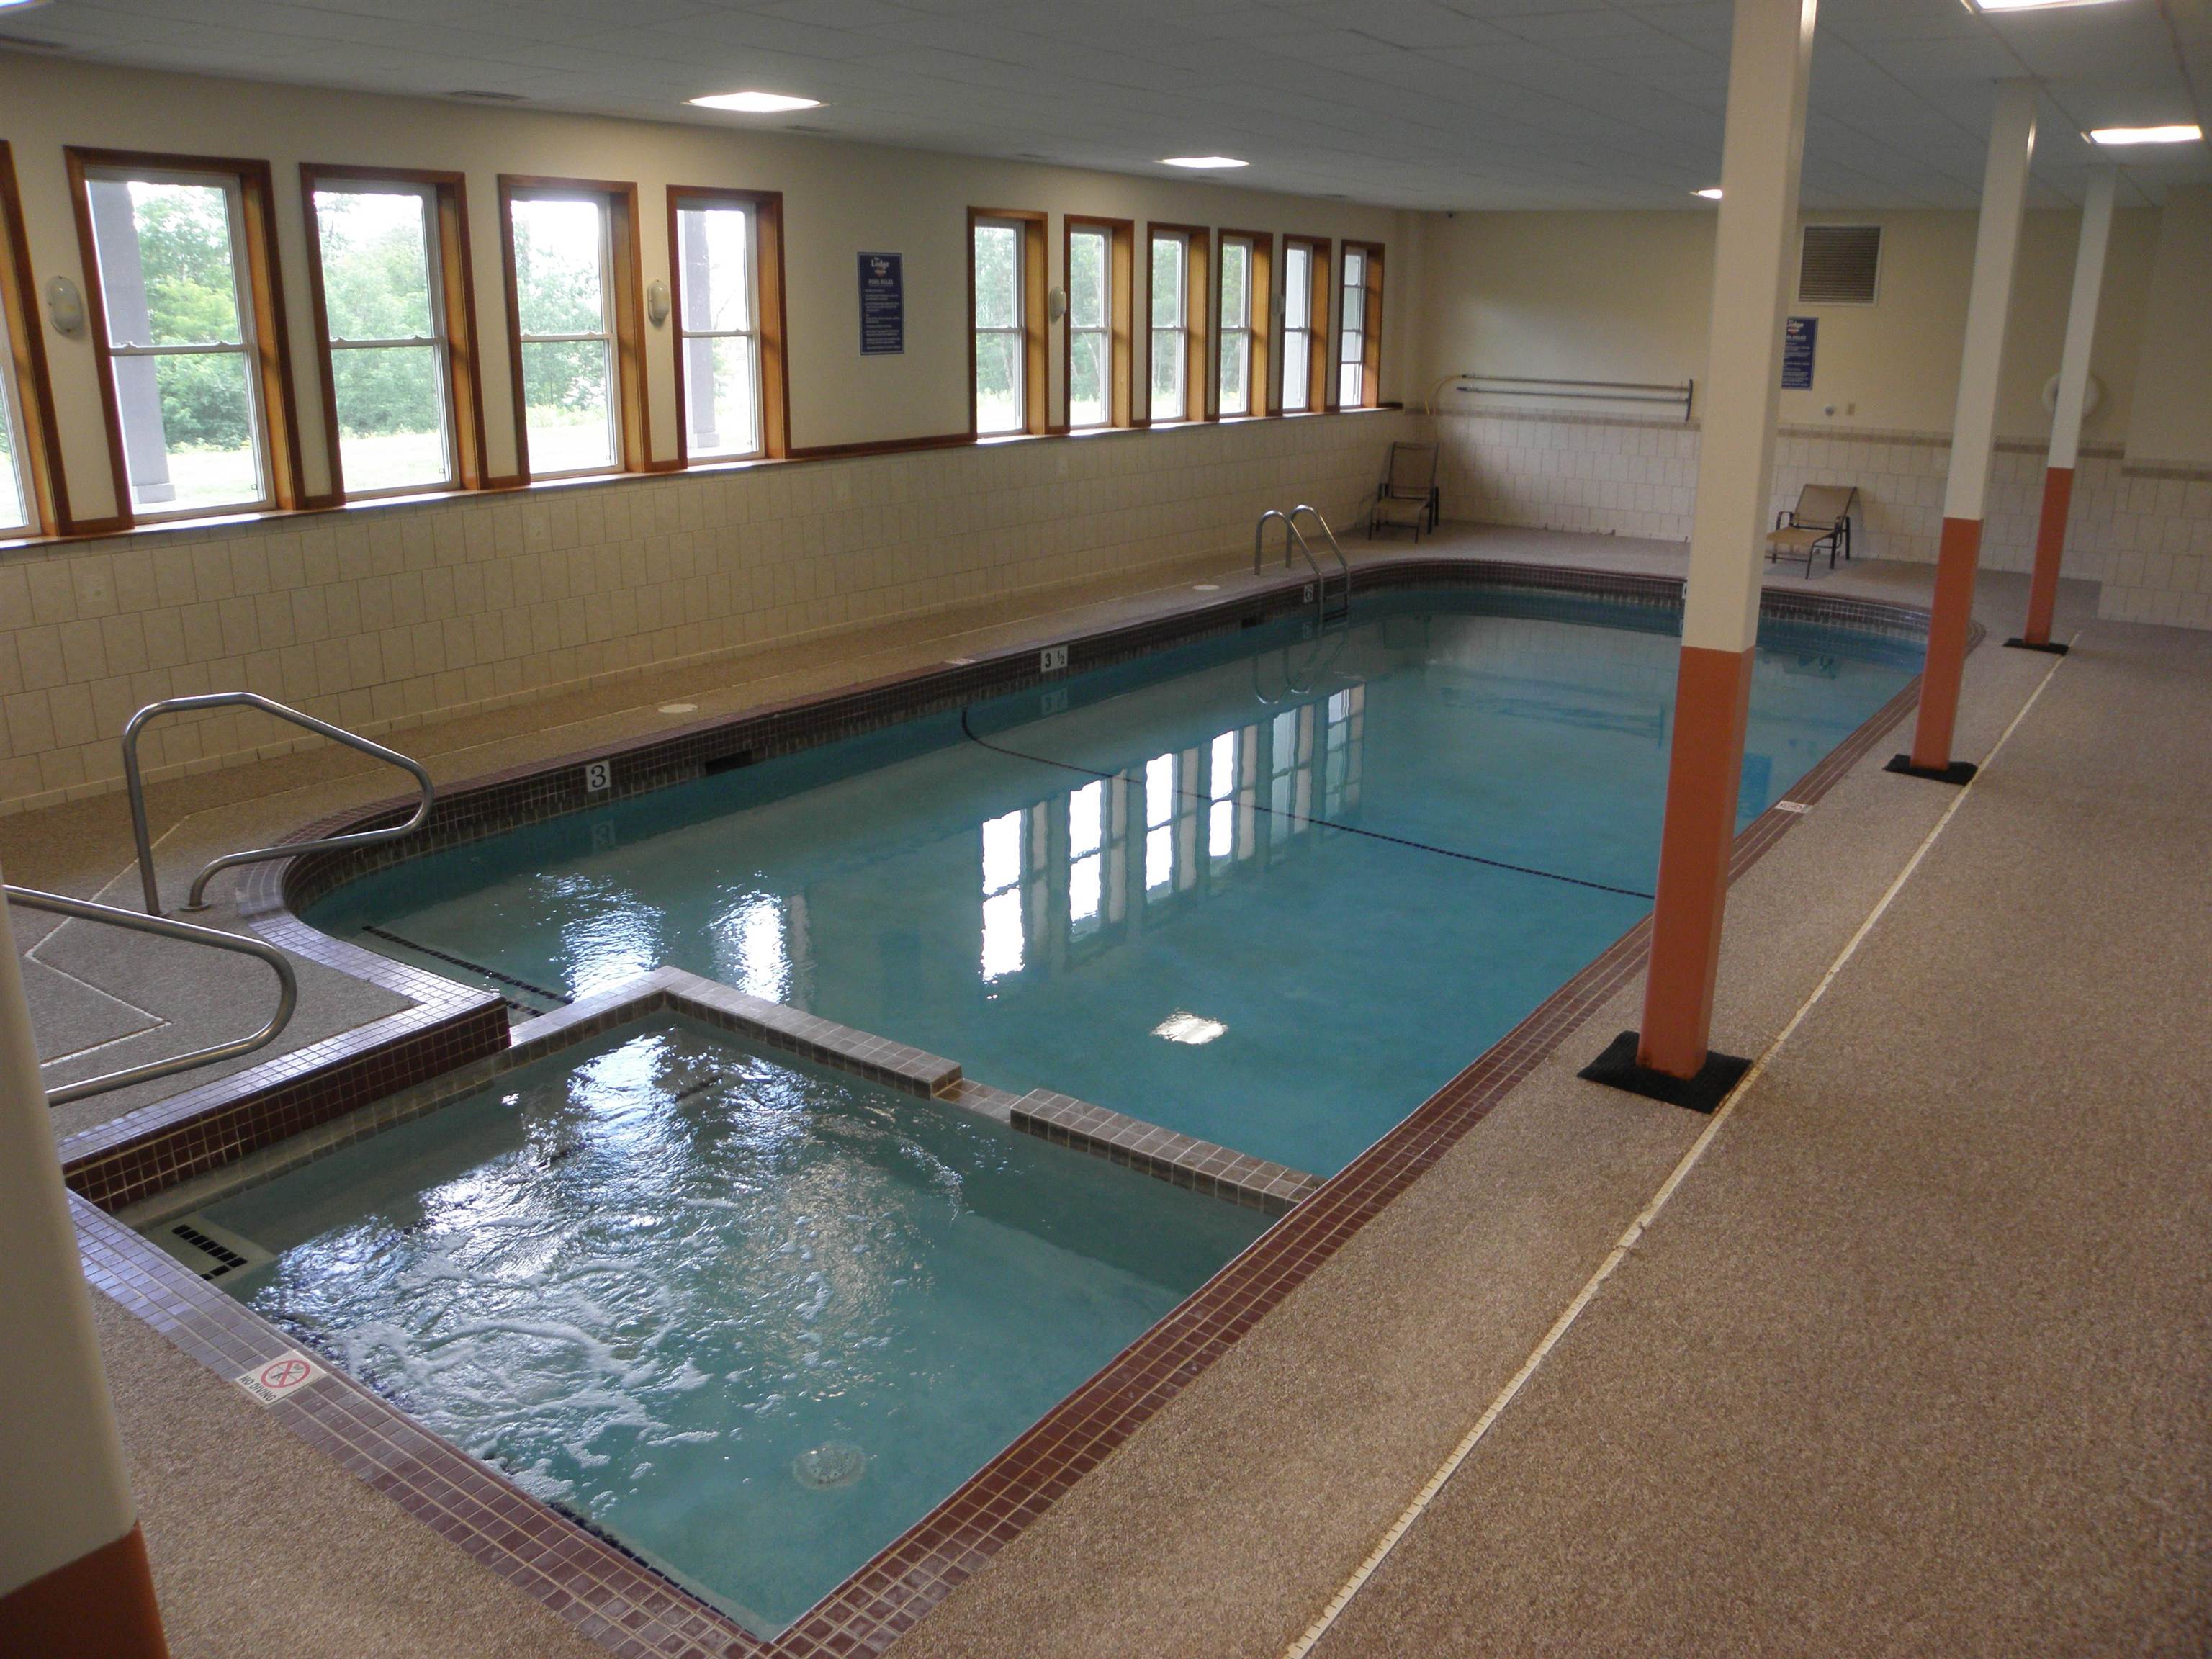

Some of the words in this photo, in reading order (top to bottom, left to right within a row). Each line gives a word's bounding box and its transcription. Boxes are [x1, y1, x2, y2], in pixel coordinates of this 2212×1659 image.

[1305, 586, 1312, 601] 6
[1045, 653, 1051, 668] 3
[591, 765, 606, 788] 3
[240, 1375, 255, 1385] NO
[249, 1383, 276, 1401] DIVING
